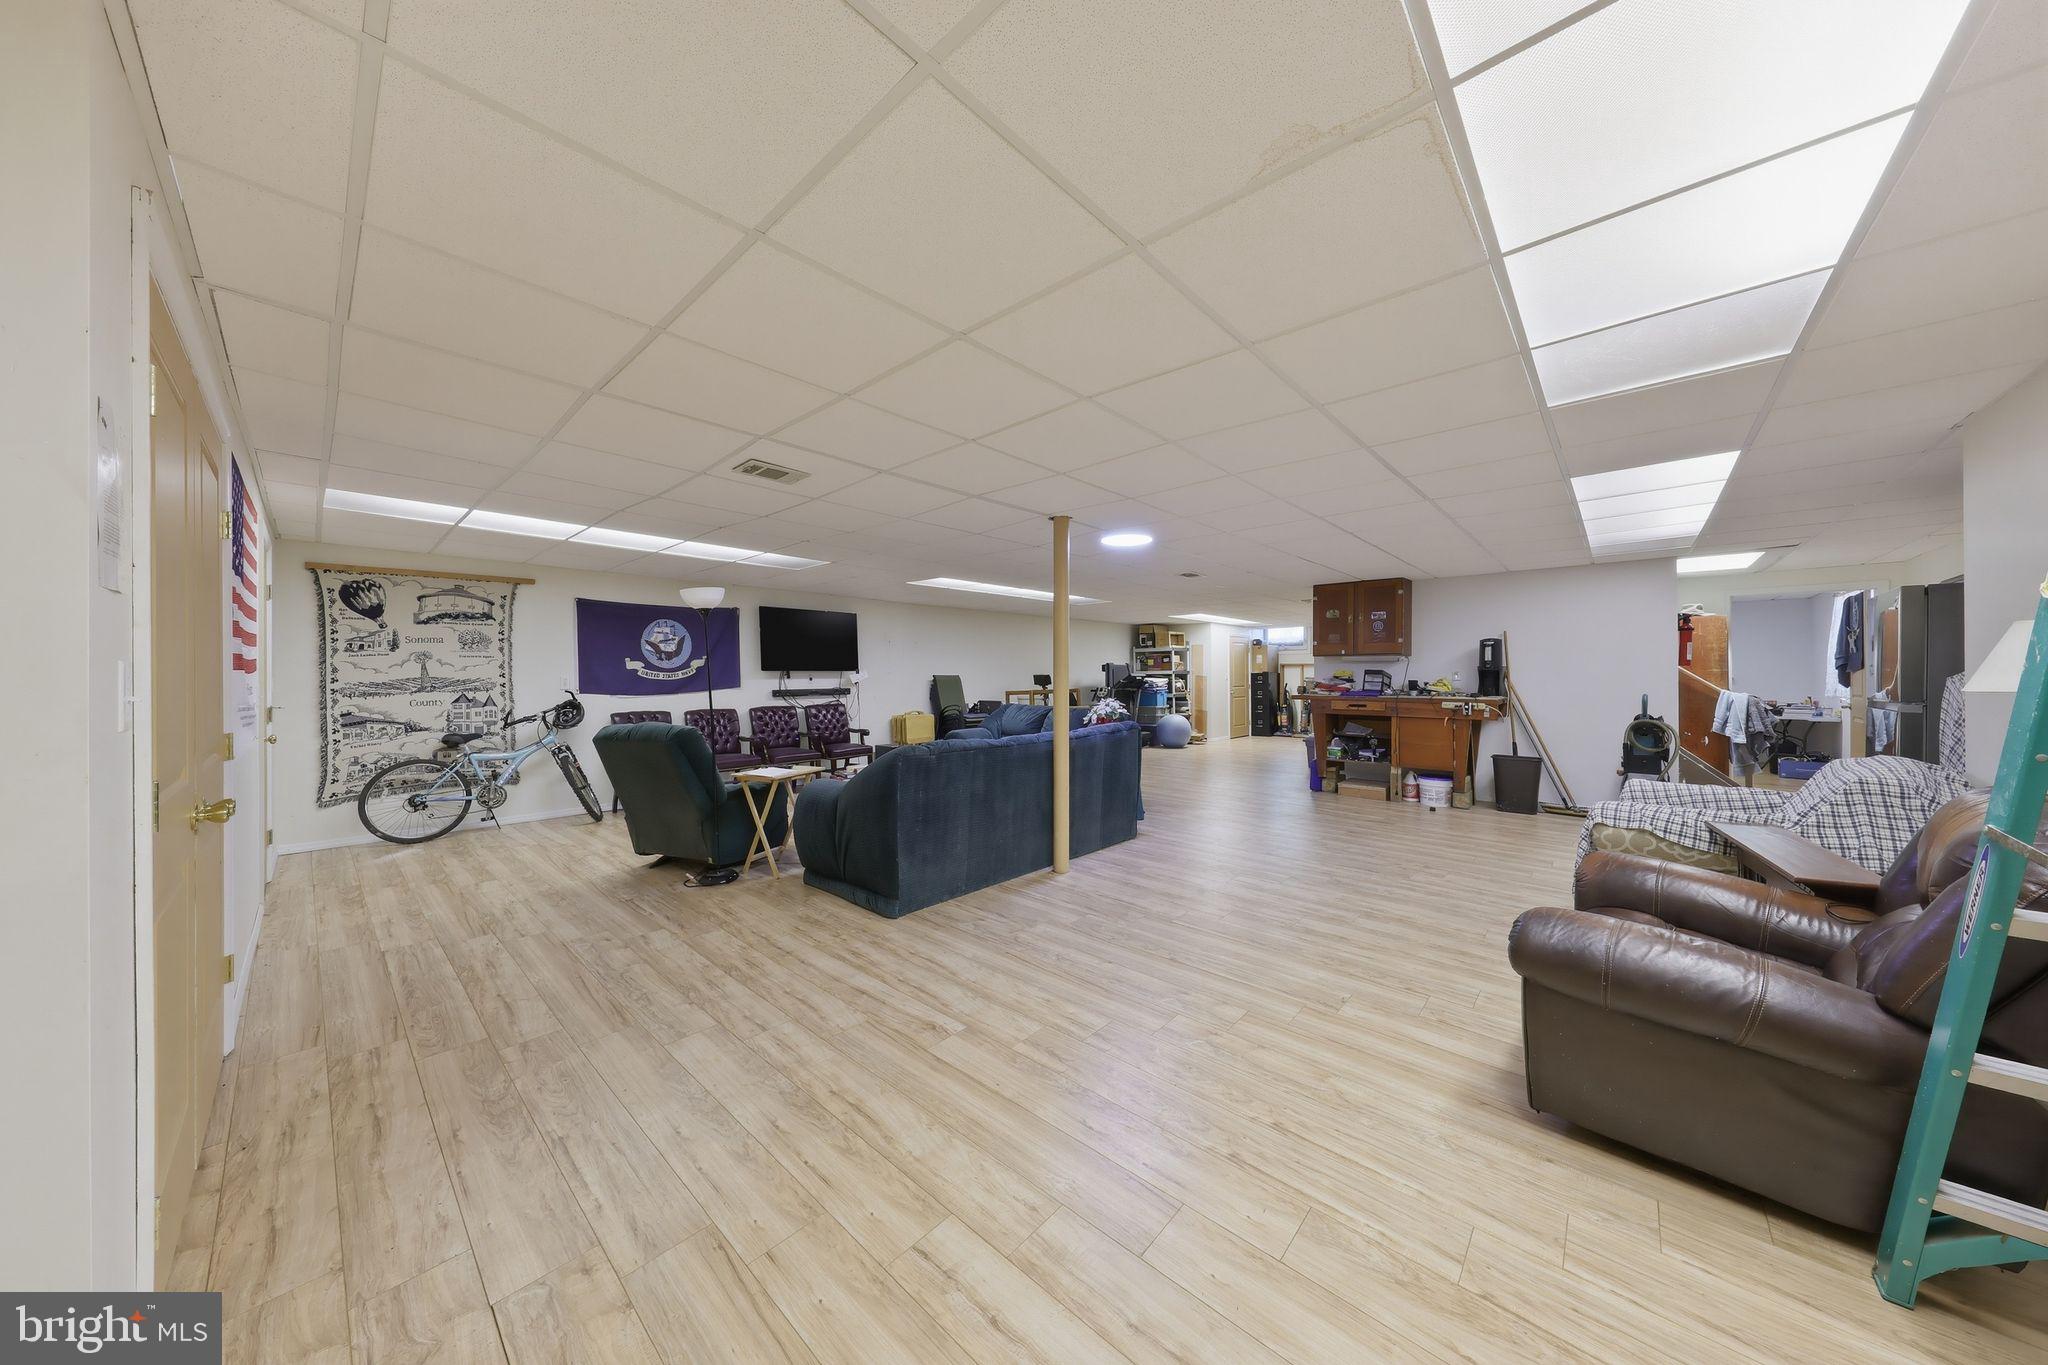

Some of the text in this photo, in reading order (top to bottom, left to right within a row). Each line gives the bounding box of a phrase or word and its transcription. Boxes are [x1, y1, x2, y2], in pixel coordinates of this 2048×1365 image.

[404, 635, 444, 644] Sonoma
[640, 669, 660, 679] UNITED
[409, 699, 445, 708] County
[1964, 867, 1985, 936] WERNER
